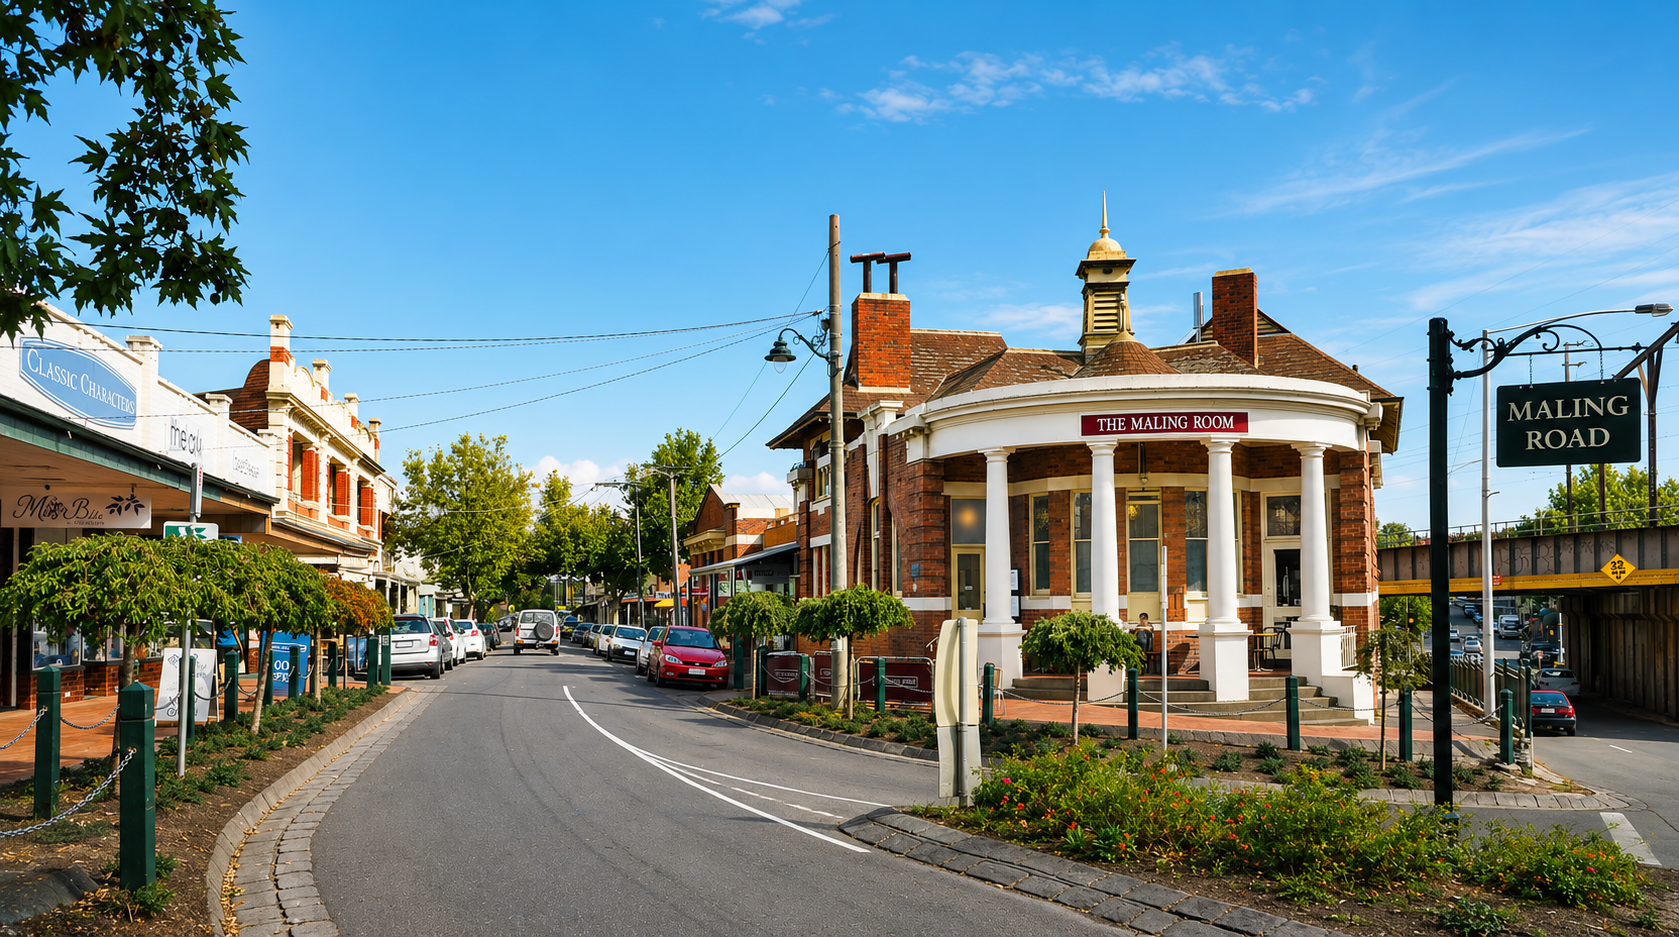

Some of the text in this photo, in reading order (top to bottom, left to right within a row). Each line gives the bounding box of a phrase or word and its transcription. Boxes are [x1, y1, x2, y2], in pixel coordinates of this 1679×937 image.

[27, 348, 78, 391] CLASSIC
[1507, 395, 1630, 422] MALING
[1097, 415, 1234, 431] THE MALING ROOM
[1525, 427, 1611, 451] ROAD
